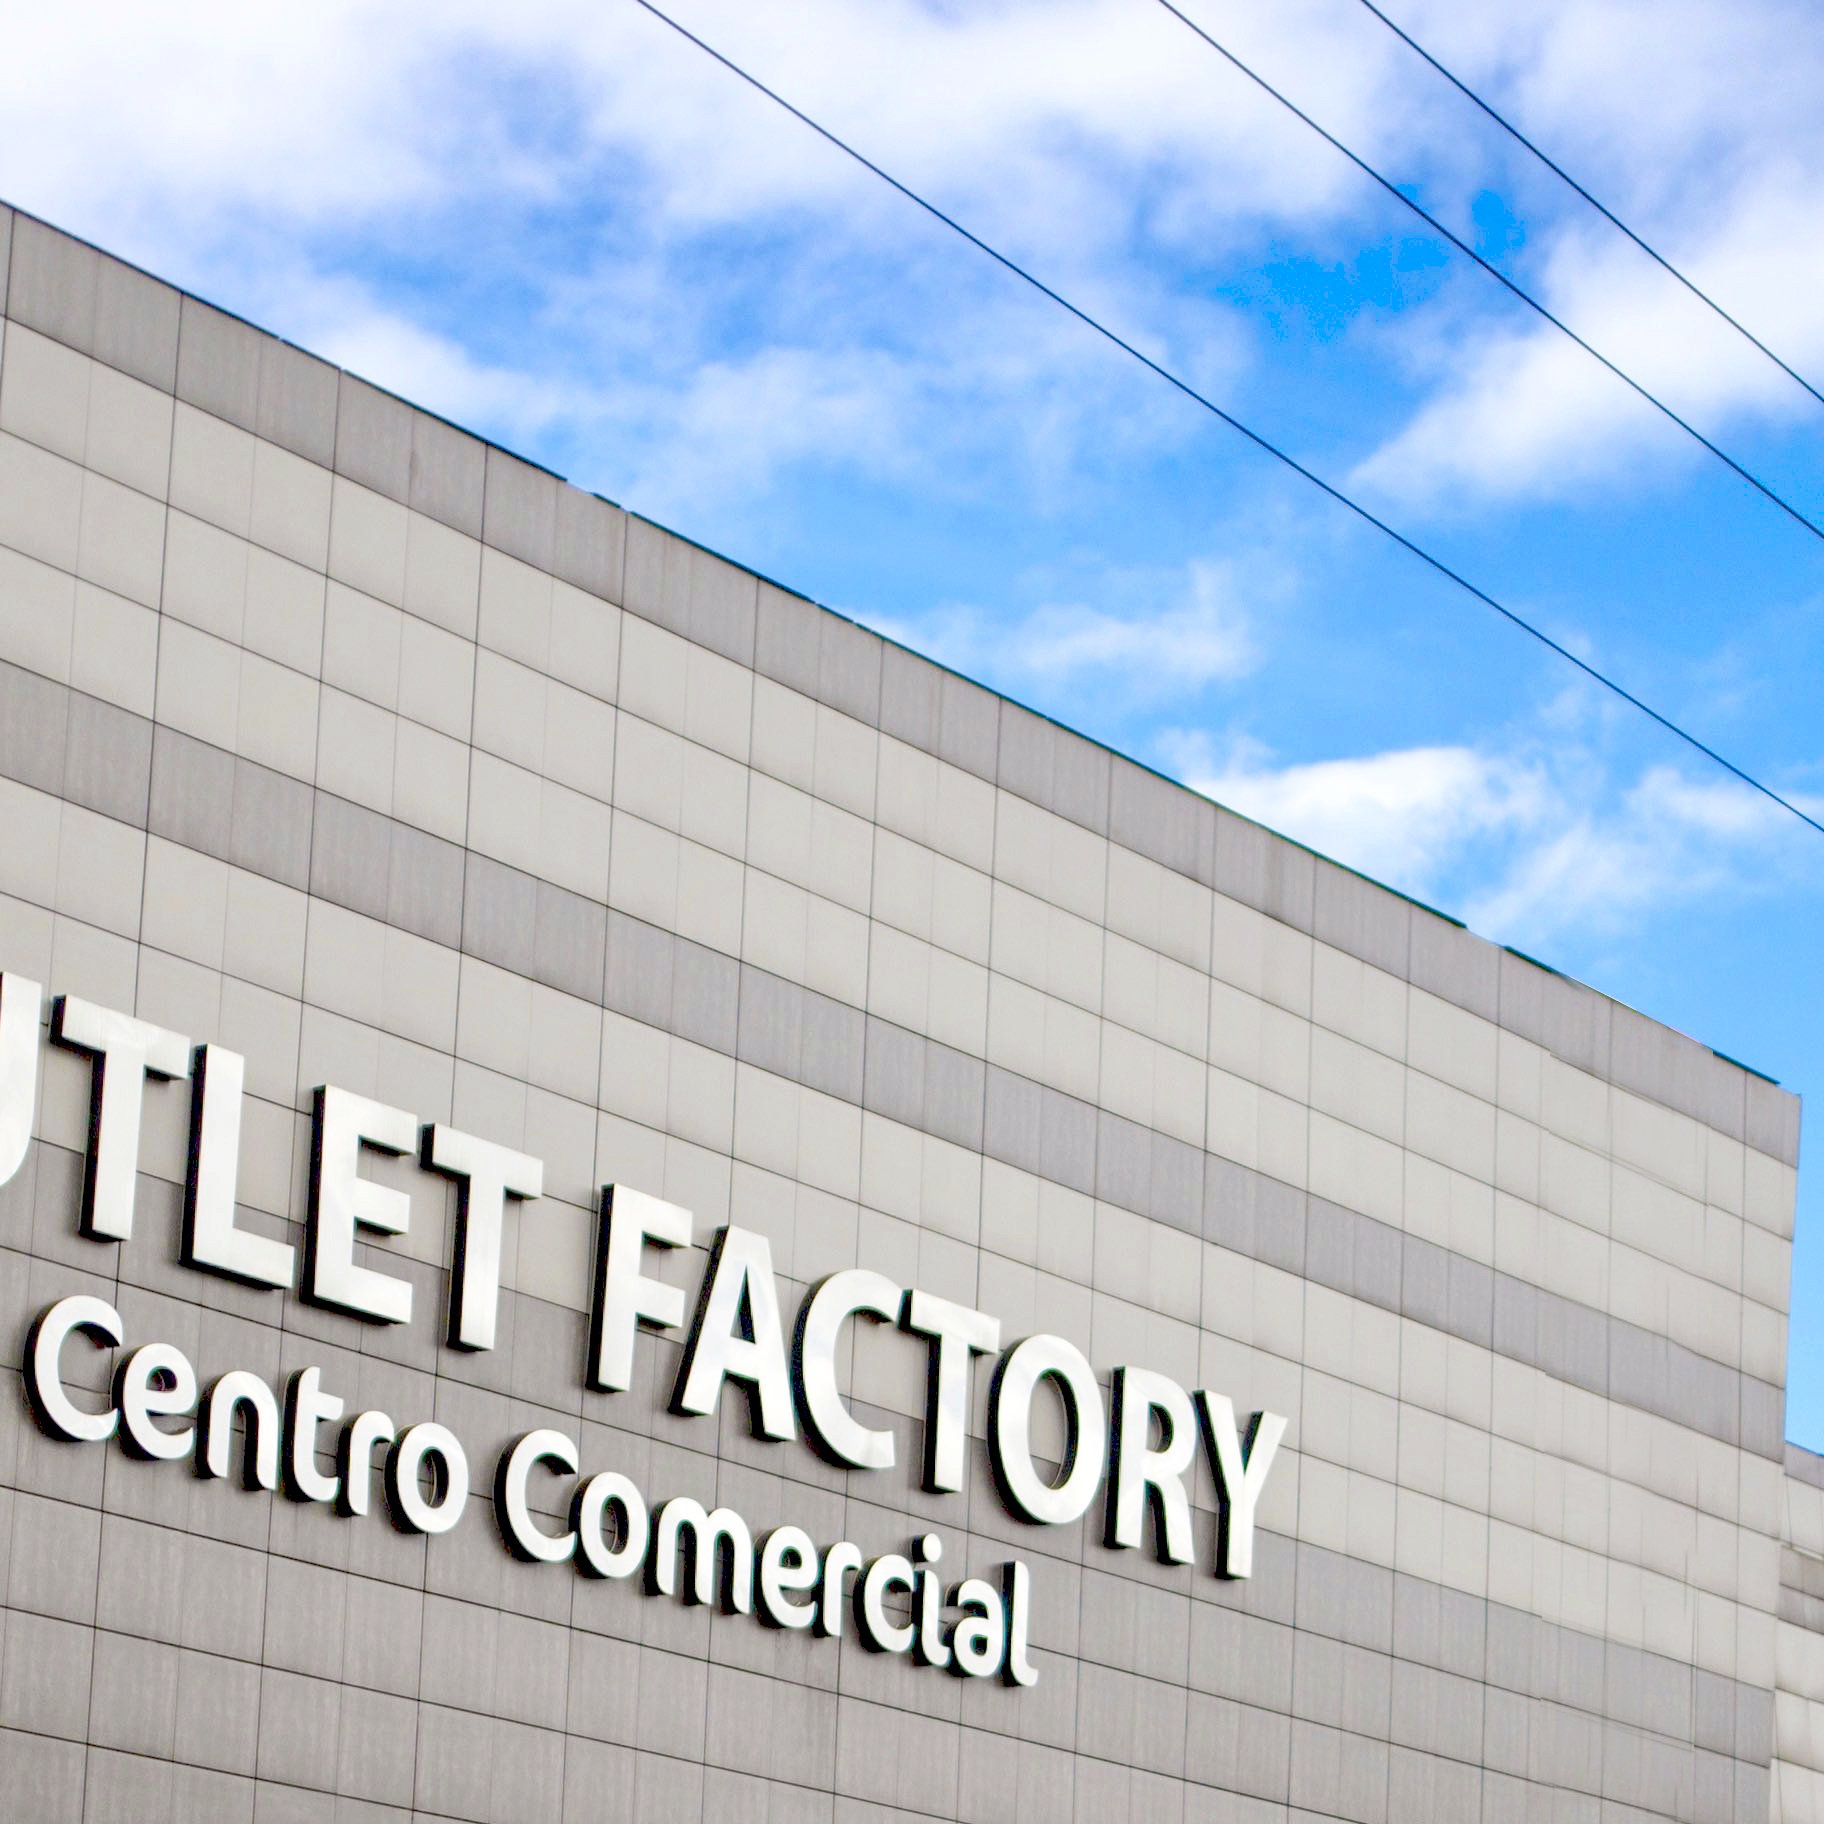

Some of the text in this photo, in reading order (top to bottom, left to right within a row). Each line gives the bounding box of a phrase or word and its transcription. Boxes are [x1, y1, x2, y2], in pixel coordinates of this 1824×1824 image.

[26, 1295, 1038, 1688] Centro Comercial
[588, 1183, 1289, 1580] FACTORY
